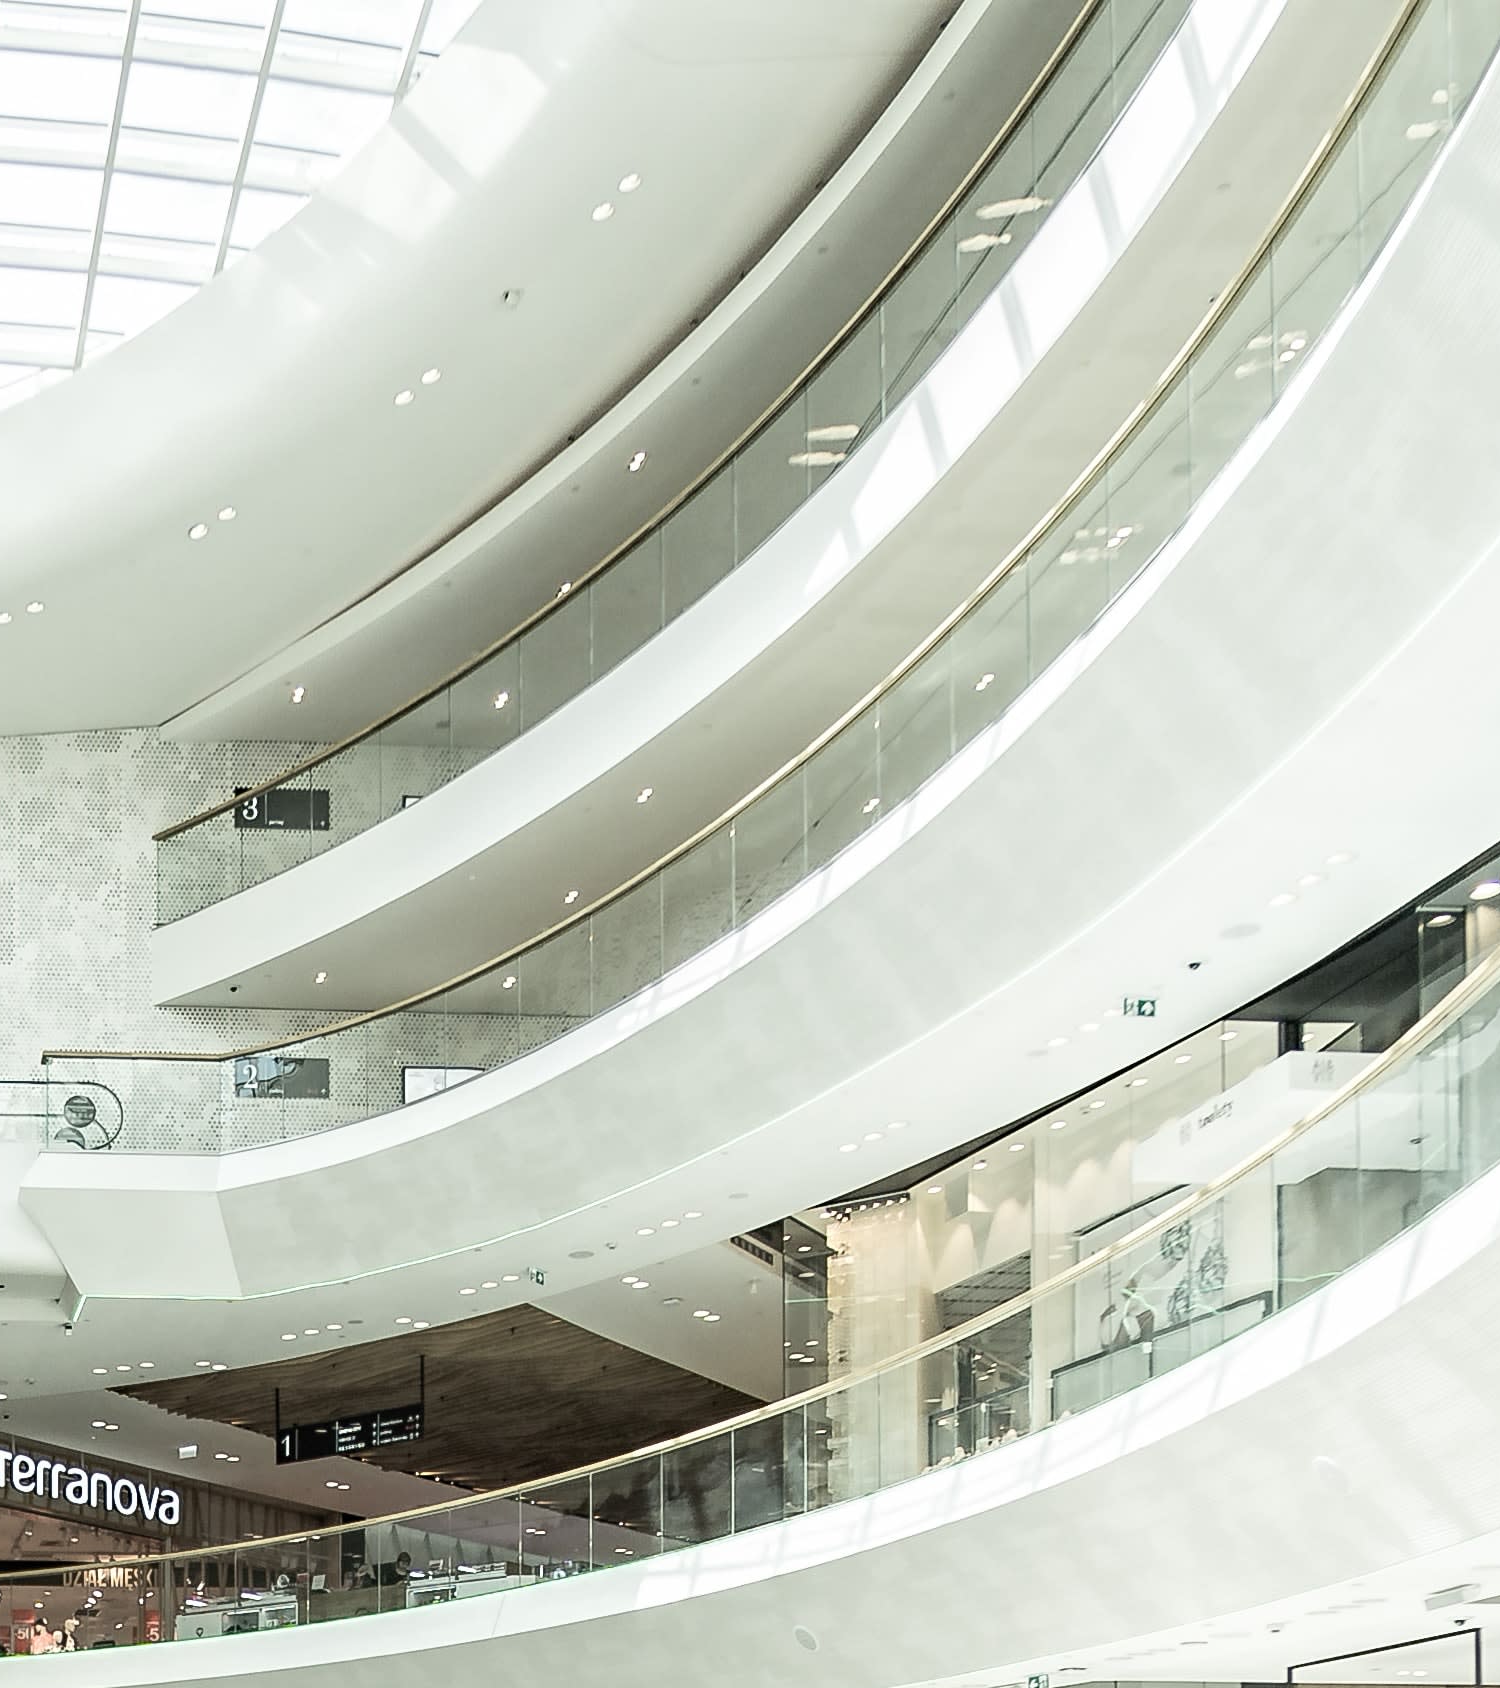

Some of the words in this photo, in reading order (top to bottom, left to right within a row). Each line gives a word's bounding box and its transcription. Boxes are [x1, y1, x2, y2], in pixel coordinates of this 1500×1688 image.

[242, 797, 258, 821] 3
[243, 1064, 258, 1089] 2
[280, 1434, 290, 1457] 1
